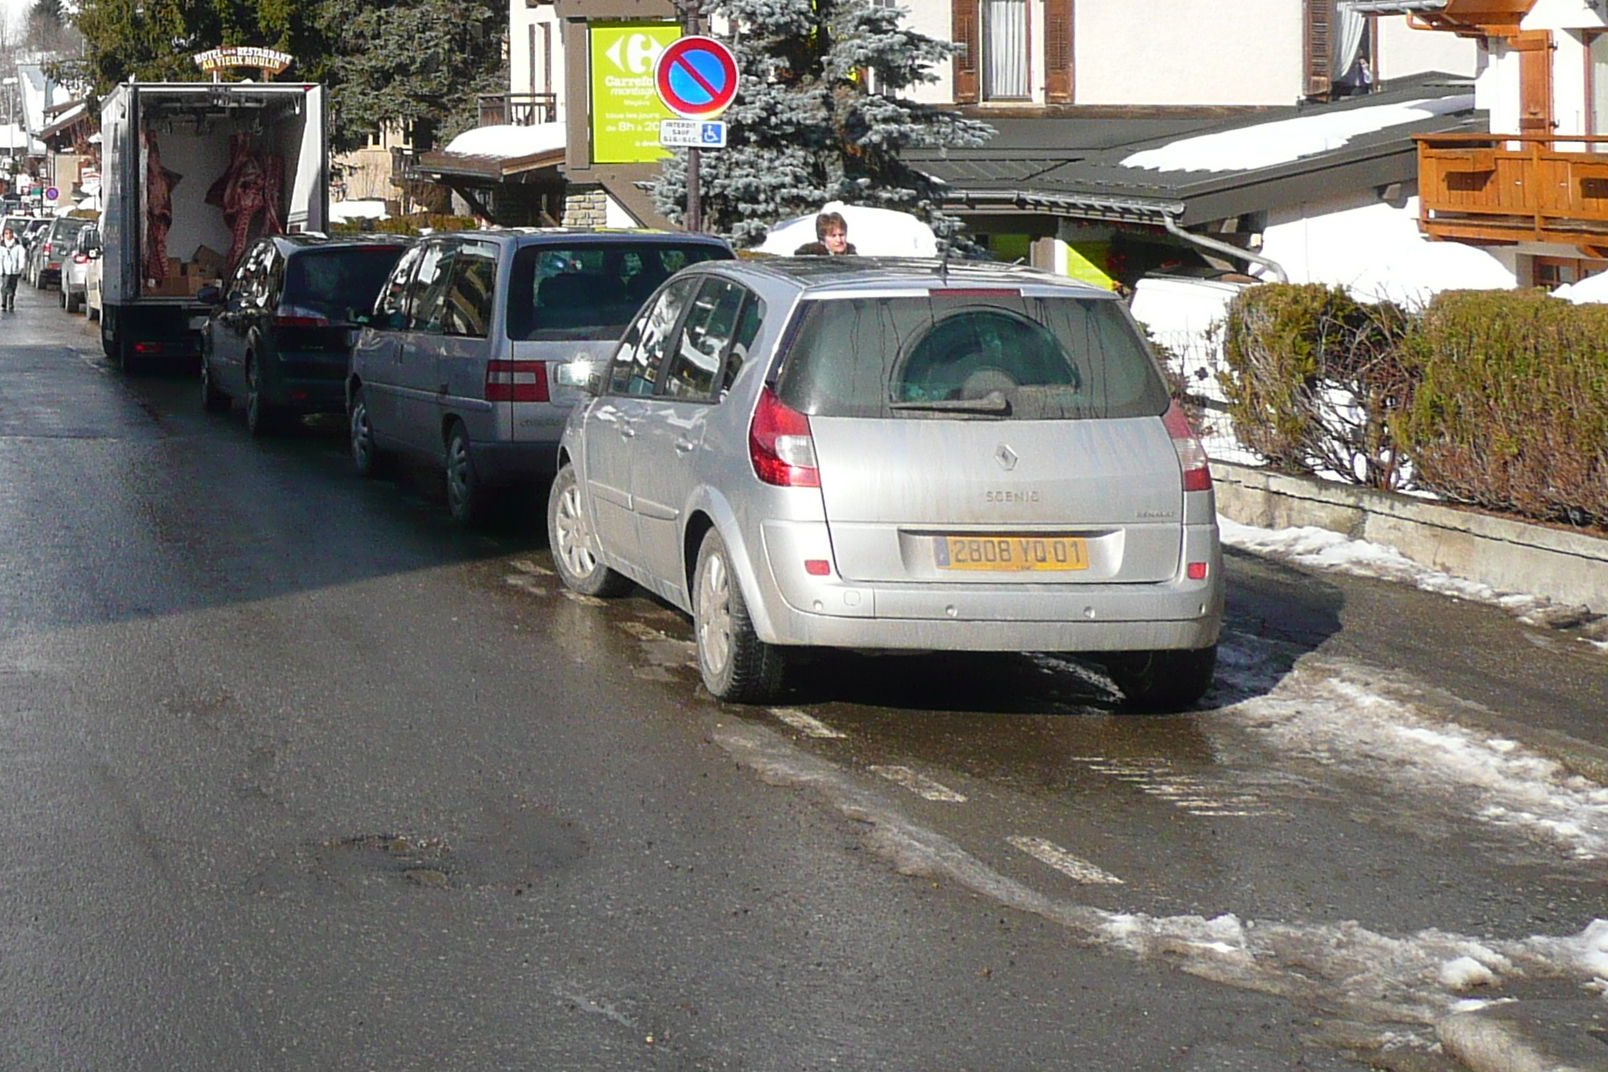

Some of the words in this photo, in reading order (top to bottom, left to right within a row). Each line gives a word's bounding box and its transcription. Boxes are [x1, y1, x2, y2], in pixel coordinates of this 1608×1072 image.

[193, 49, 223, 64] HOTEL
[237, 46, 293, 65] RESTAURANT
[202, 59, 215, 70] AU
[215, 56, 244, 66] VIEUX
[244, 56, 281, 69] MOULIN
[604, 75, 654, 87] Carrefo
[618, 121, 635, 132] 8h
[644, 121, 660, 132] 20
[985, 491, 1040, 502] SCENIC
[953, 540, 1012, 563] 2808
[1017, 540, 1049, 563] YQ
[1053, 540, 1081, 564] 01
